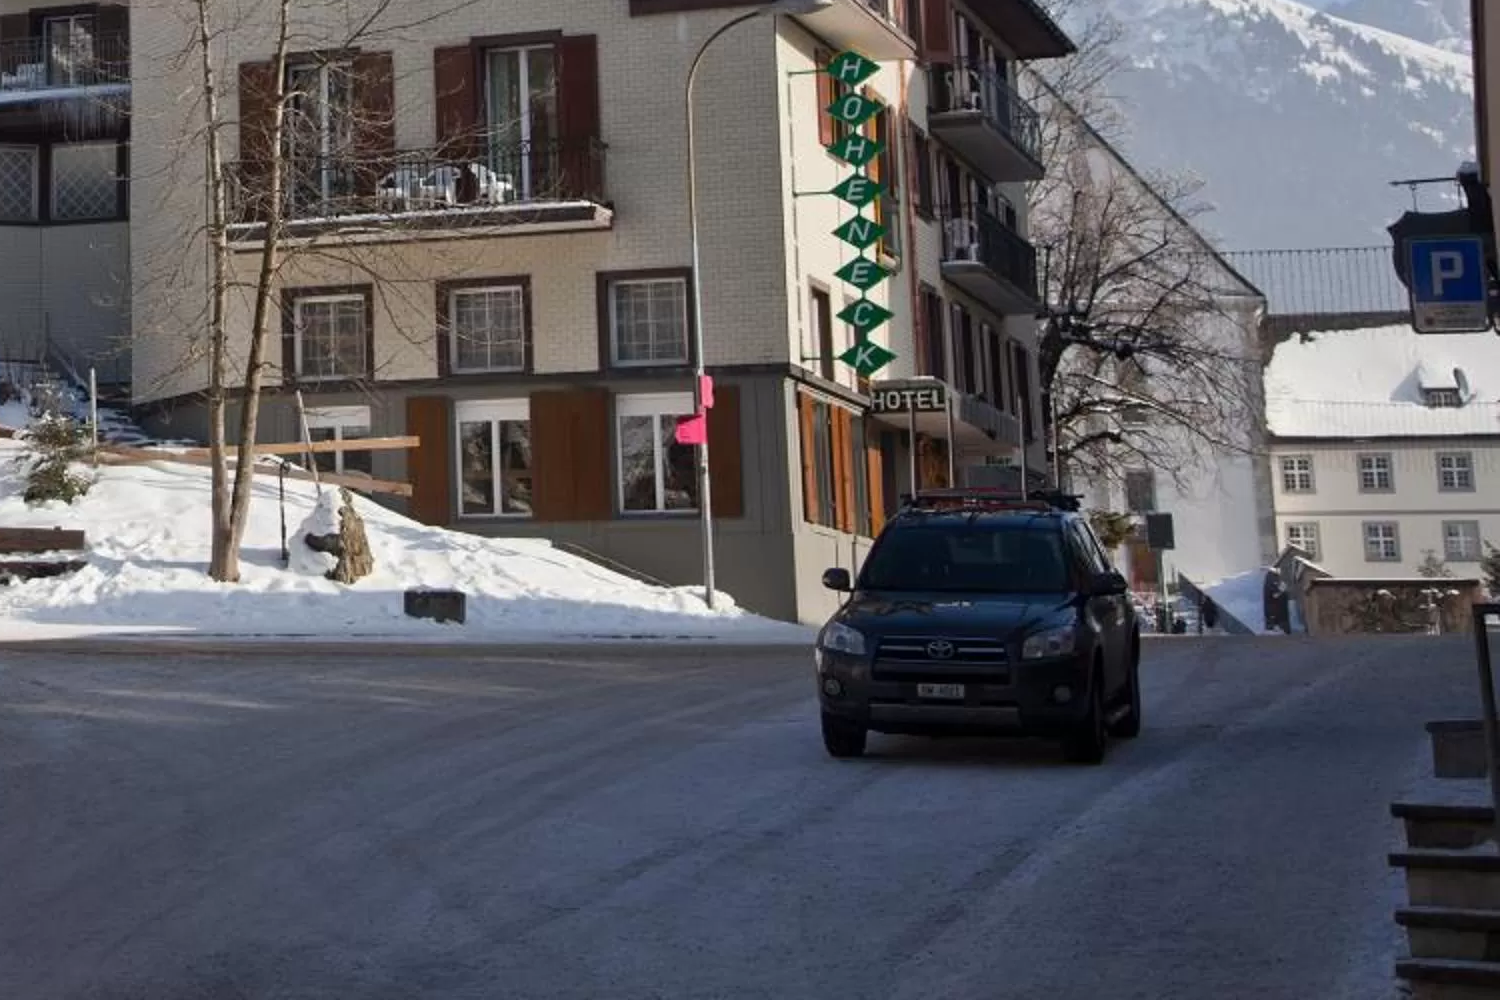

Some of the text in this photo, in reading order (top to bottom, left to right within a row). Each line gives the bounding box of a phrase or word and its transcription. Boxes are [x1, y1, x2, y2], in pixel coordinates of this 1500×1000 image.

[839, 57, 876, 367] HOHENECK
[1430, 251, 1465, 297] P
[871, 389, 945, 411] HOTEL
